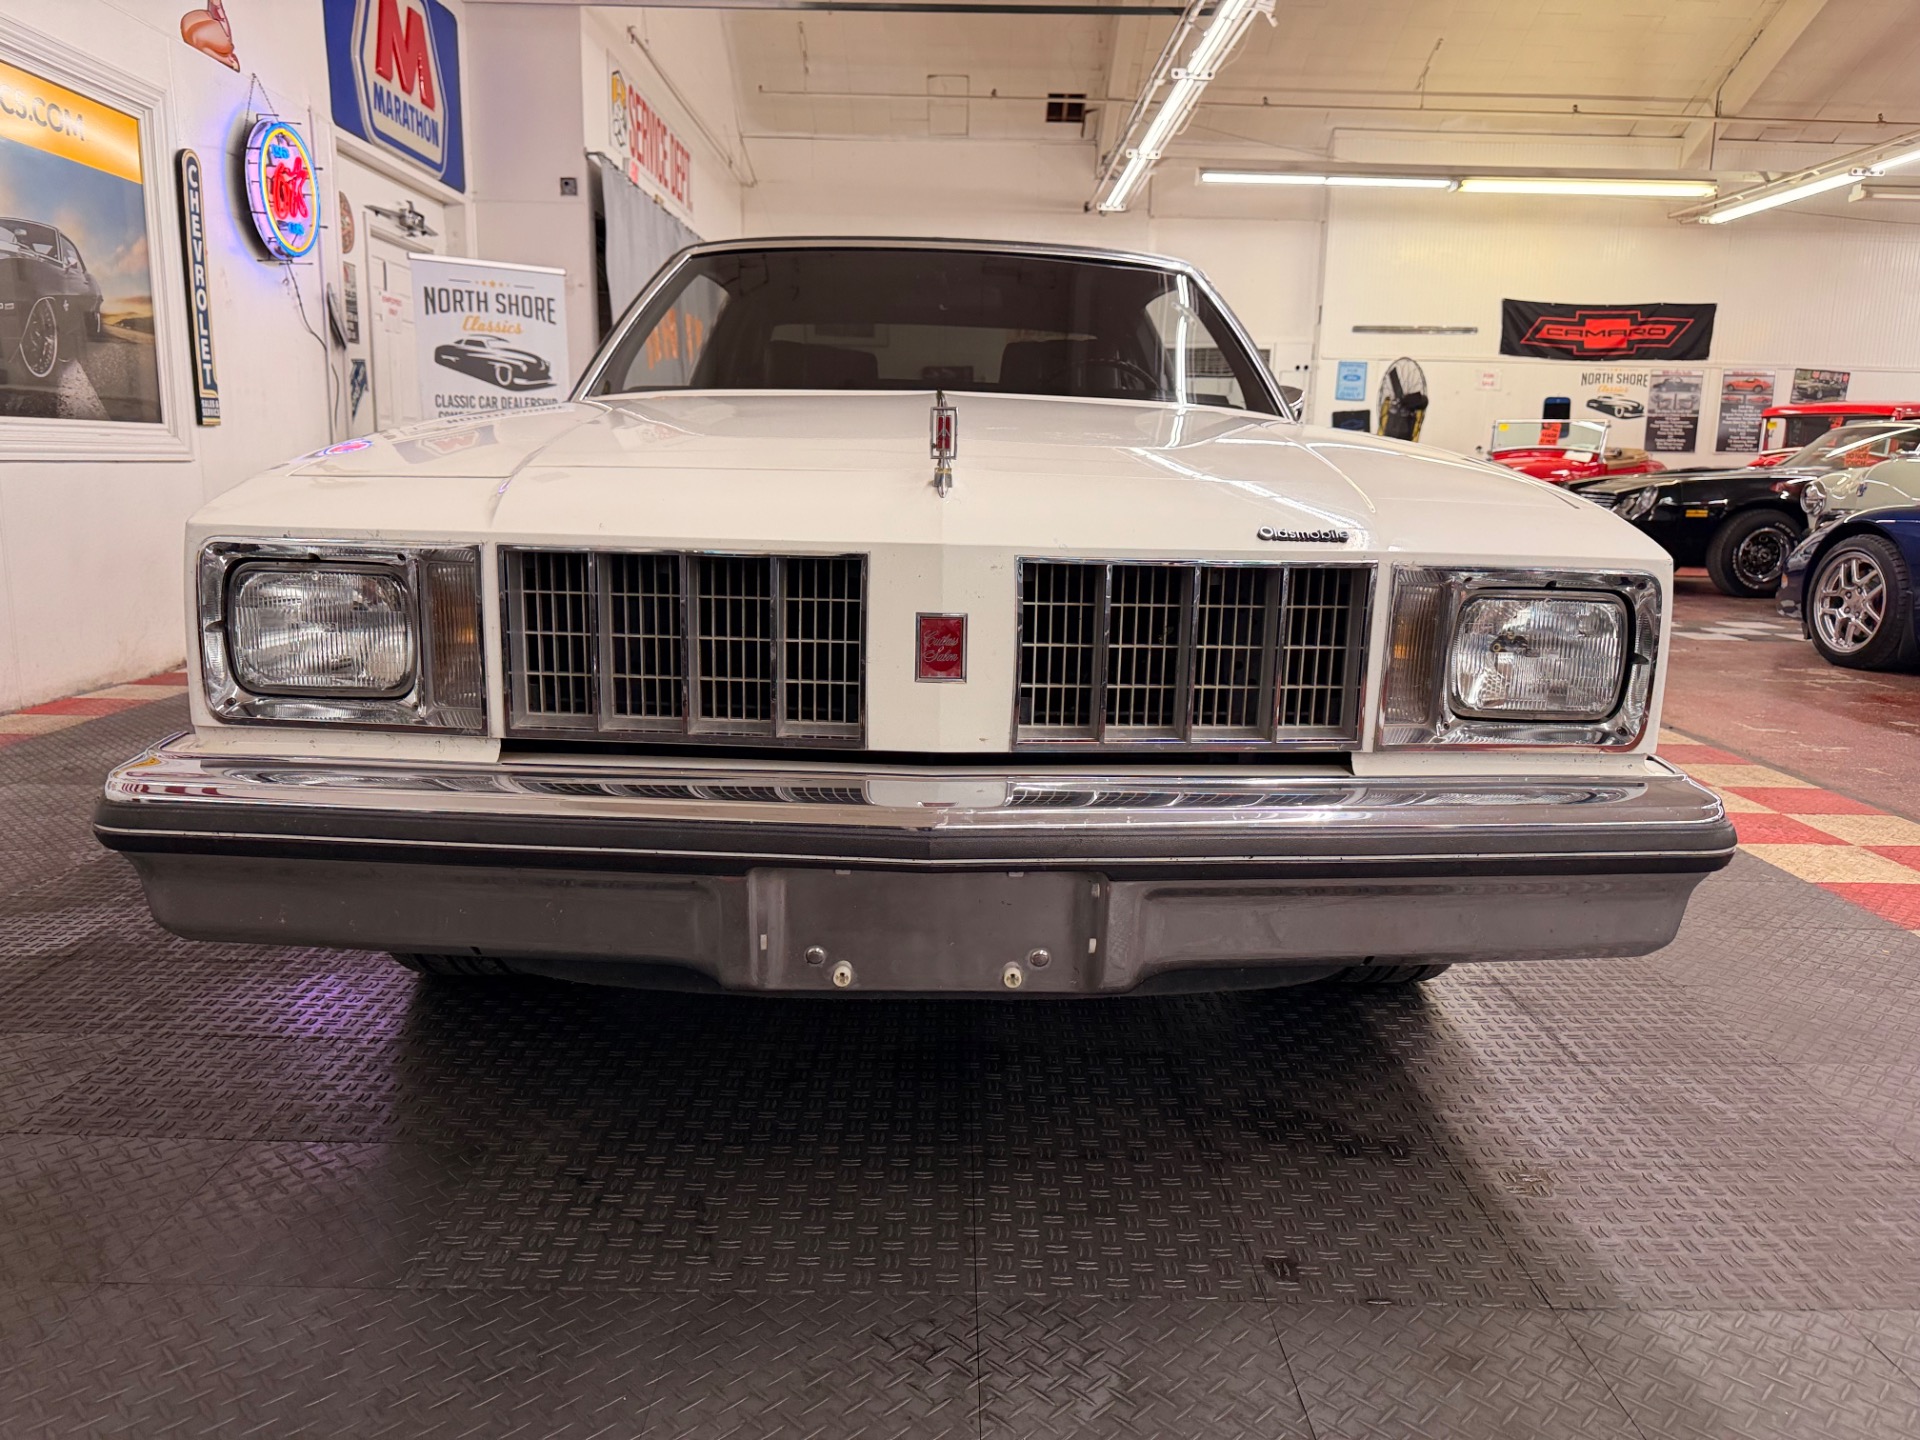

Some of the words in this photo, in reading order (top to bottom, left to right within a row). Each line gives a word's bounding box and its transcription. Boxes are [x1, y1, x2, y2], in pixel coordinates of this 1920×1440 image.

[374, 81, 439, 148] MARATHON
[628, 84, 668, 190] SERVICE
[187, 164, 213, 385] CHEVROLET
[424, 286, 489, 315] NORTH
[495, 293, 557, 325] SHORE
[462, 315, 524, 334] Classics
[1546, 327, 1667, 338] CAMARO
[1581, 372, 1614, 386] NORTH
[1616, 373, 1649, 387] SHORE
[435, 394, 477, 409] CLASSIC
[478, 396, 498, 409] CAR
[1257, 526, 1349, 543] Oldsmobile
[924, 630, 959, 647] Cutlass
